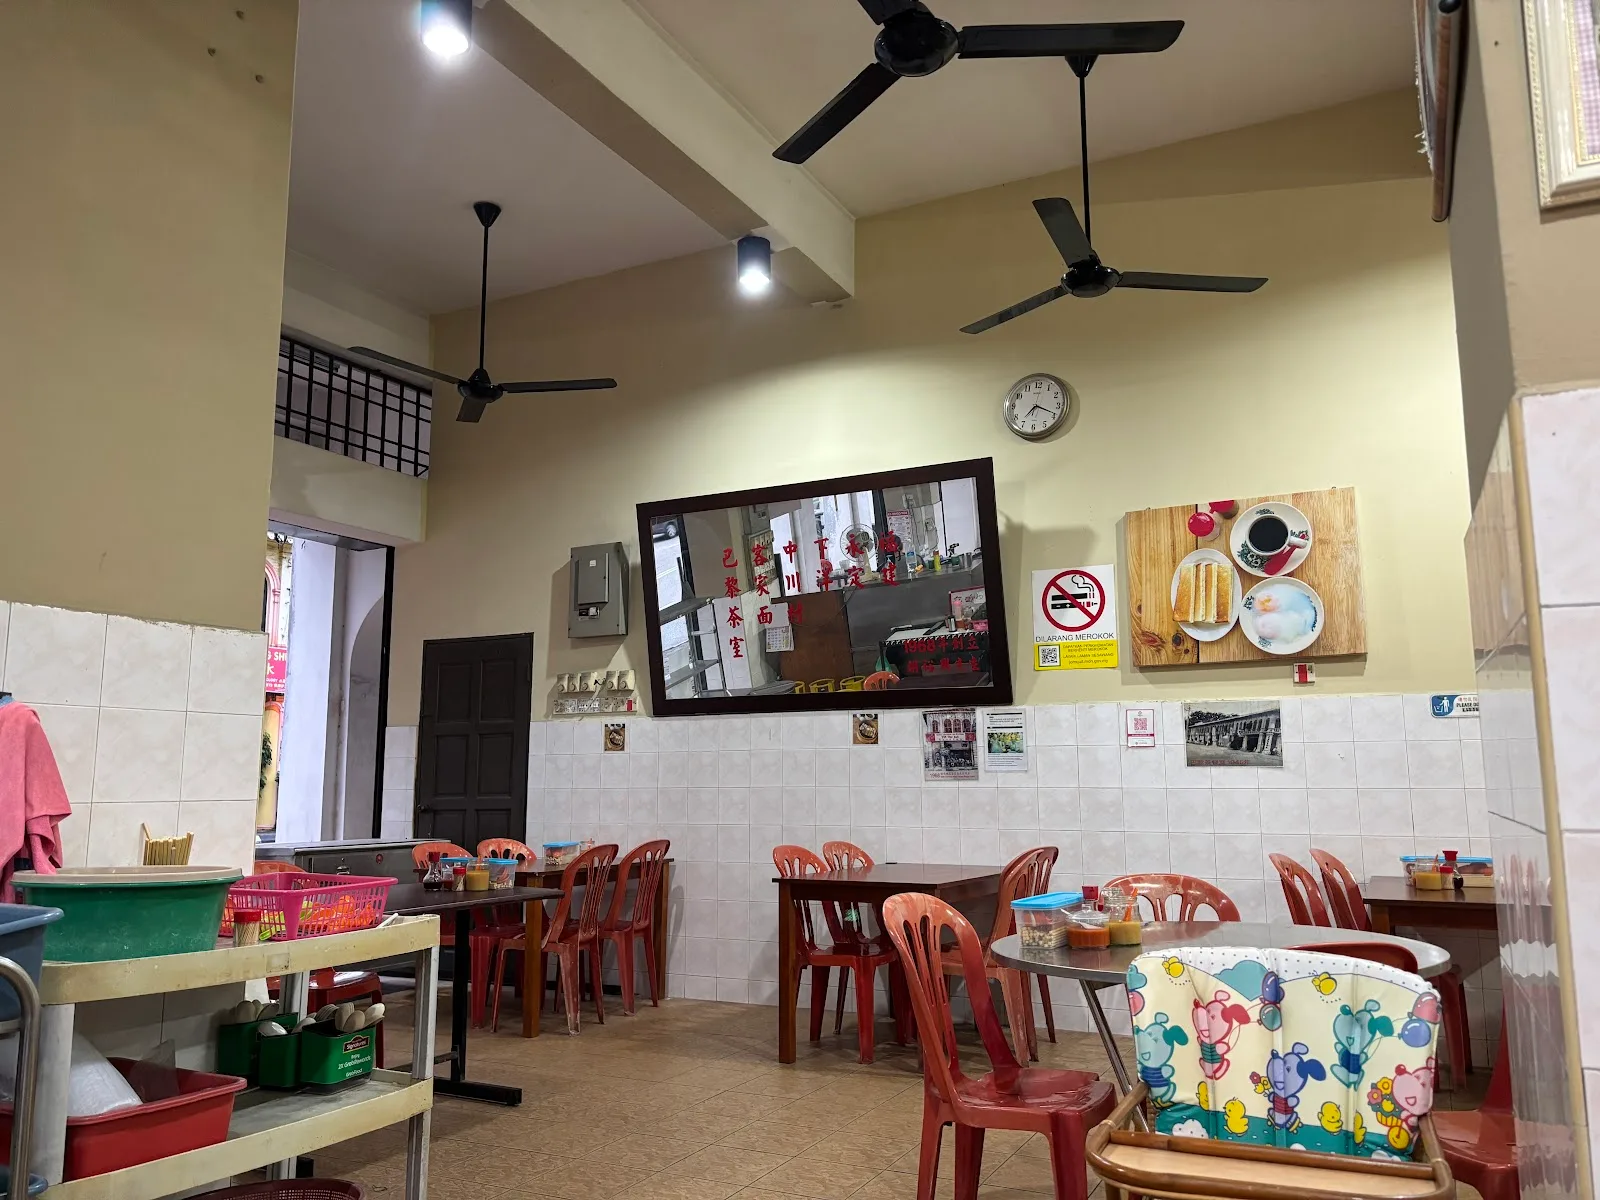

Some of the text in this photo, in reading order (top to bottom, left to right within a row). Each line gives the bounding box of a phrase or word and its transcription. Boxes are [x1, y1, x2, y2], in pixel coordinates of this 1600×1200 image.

[1024, 384, 1030, 392] 11
[752, 544, 773, 625] 客家面
[782, 540, 804, 624] 中川村
[814, 537, 833, 592] 下洋
[845, 533, 865, 590] 永定
[1075, 632, 1114, 641] MEROKOK
